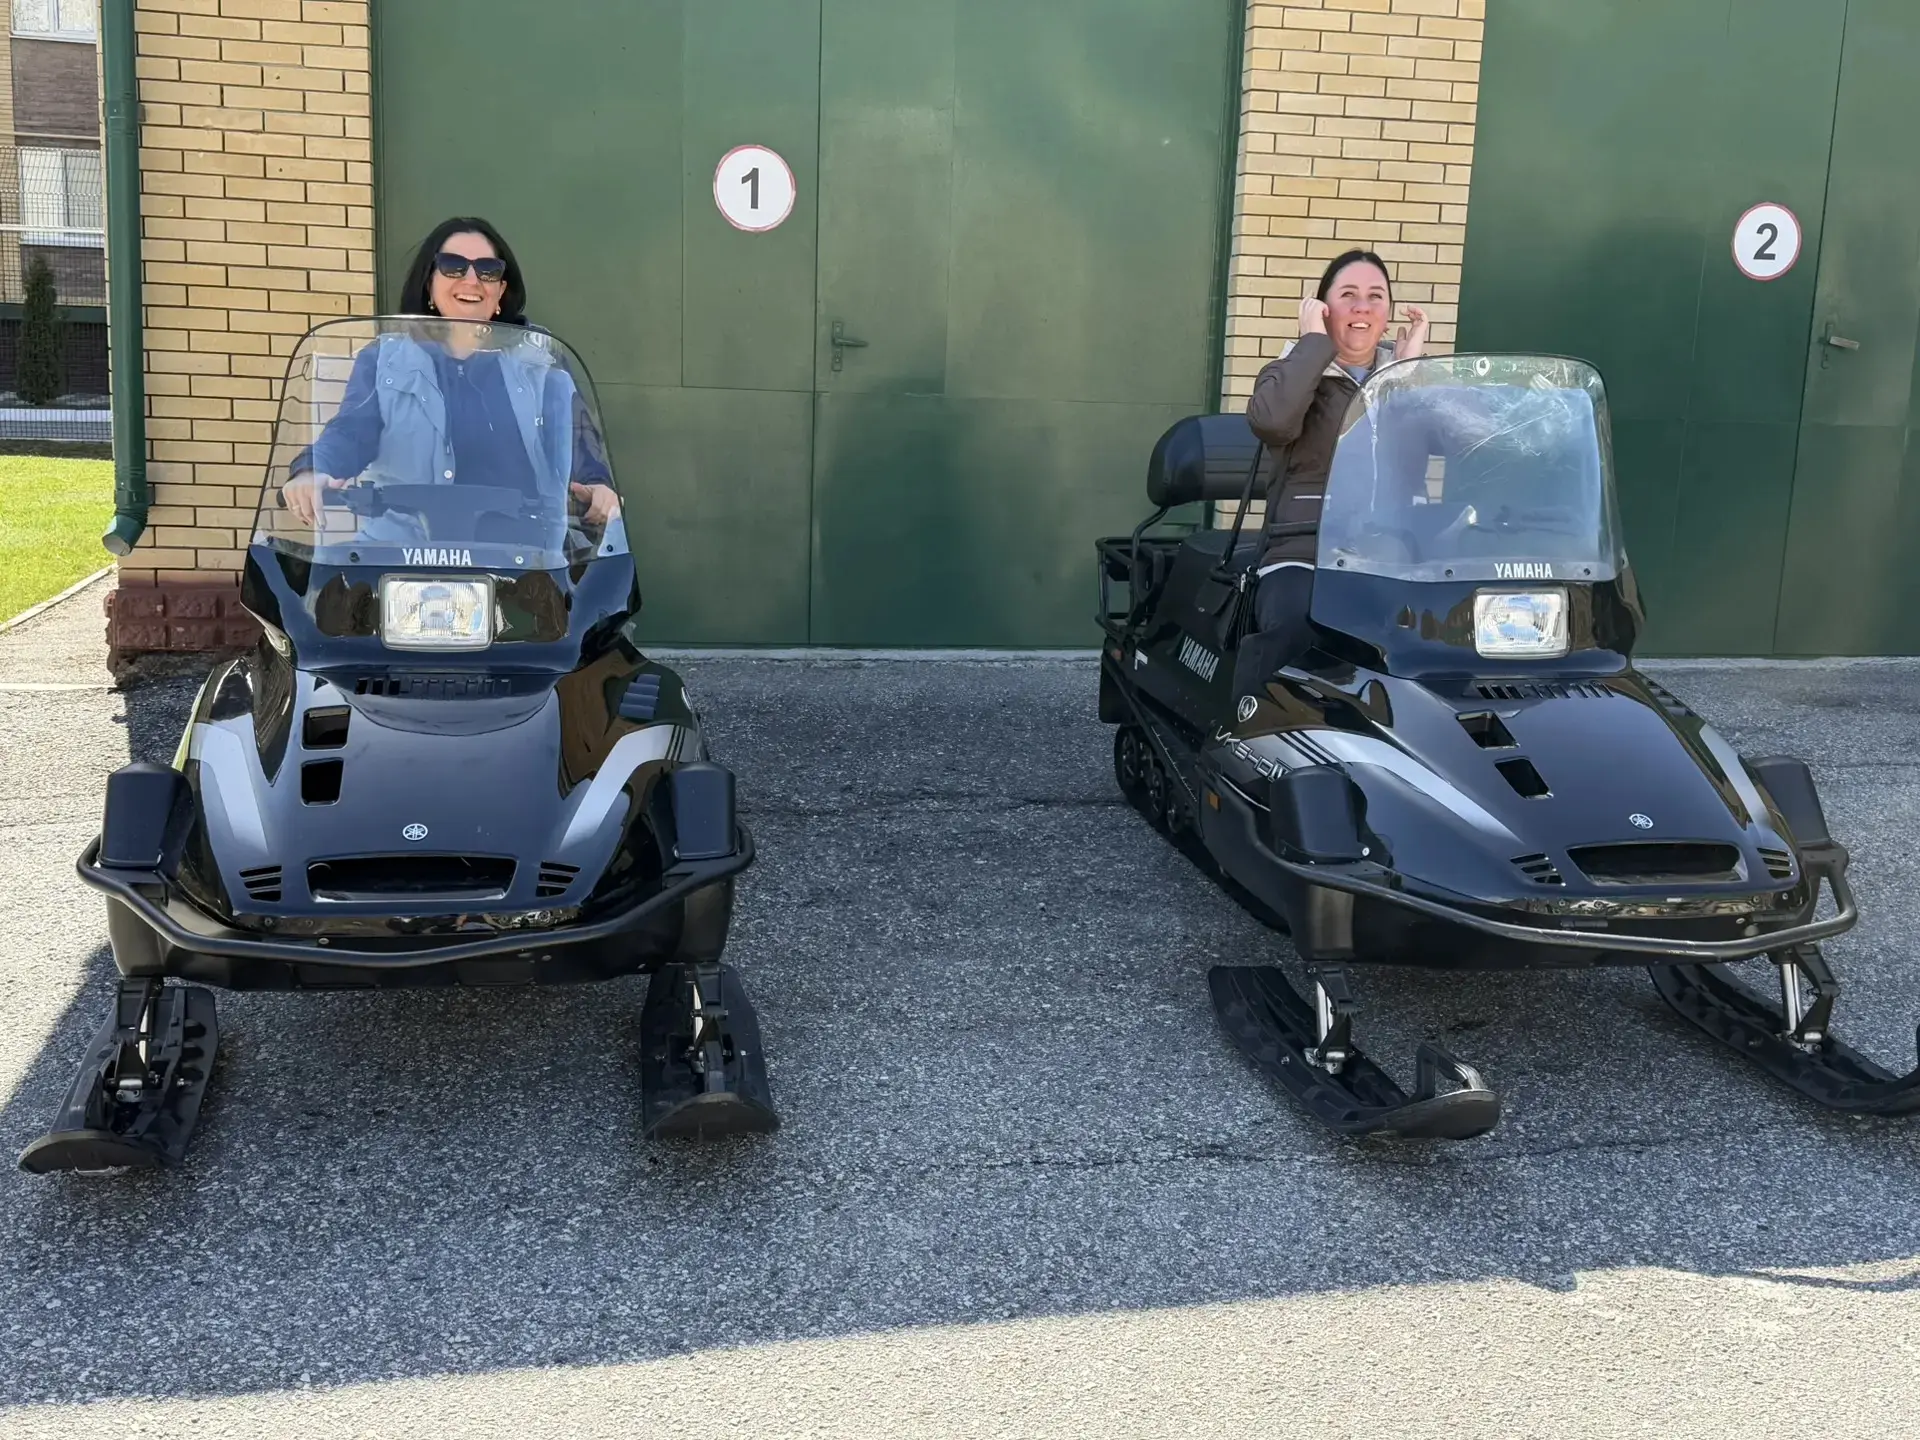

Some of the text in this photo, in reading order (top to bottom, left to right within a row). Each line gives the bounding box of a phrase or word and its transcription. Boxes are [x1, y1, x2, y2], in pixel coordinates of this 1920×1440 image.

[741, 167, 759, 209] 1
[1753, 222, 1778, 260] 2
[402, 548, 472, 566] YAMAHA
[1494, 563, 1553, 578] YAMAHA
[1179, 636, 1220, 683] YAMAHA
